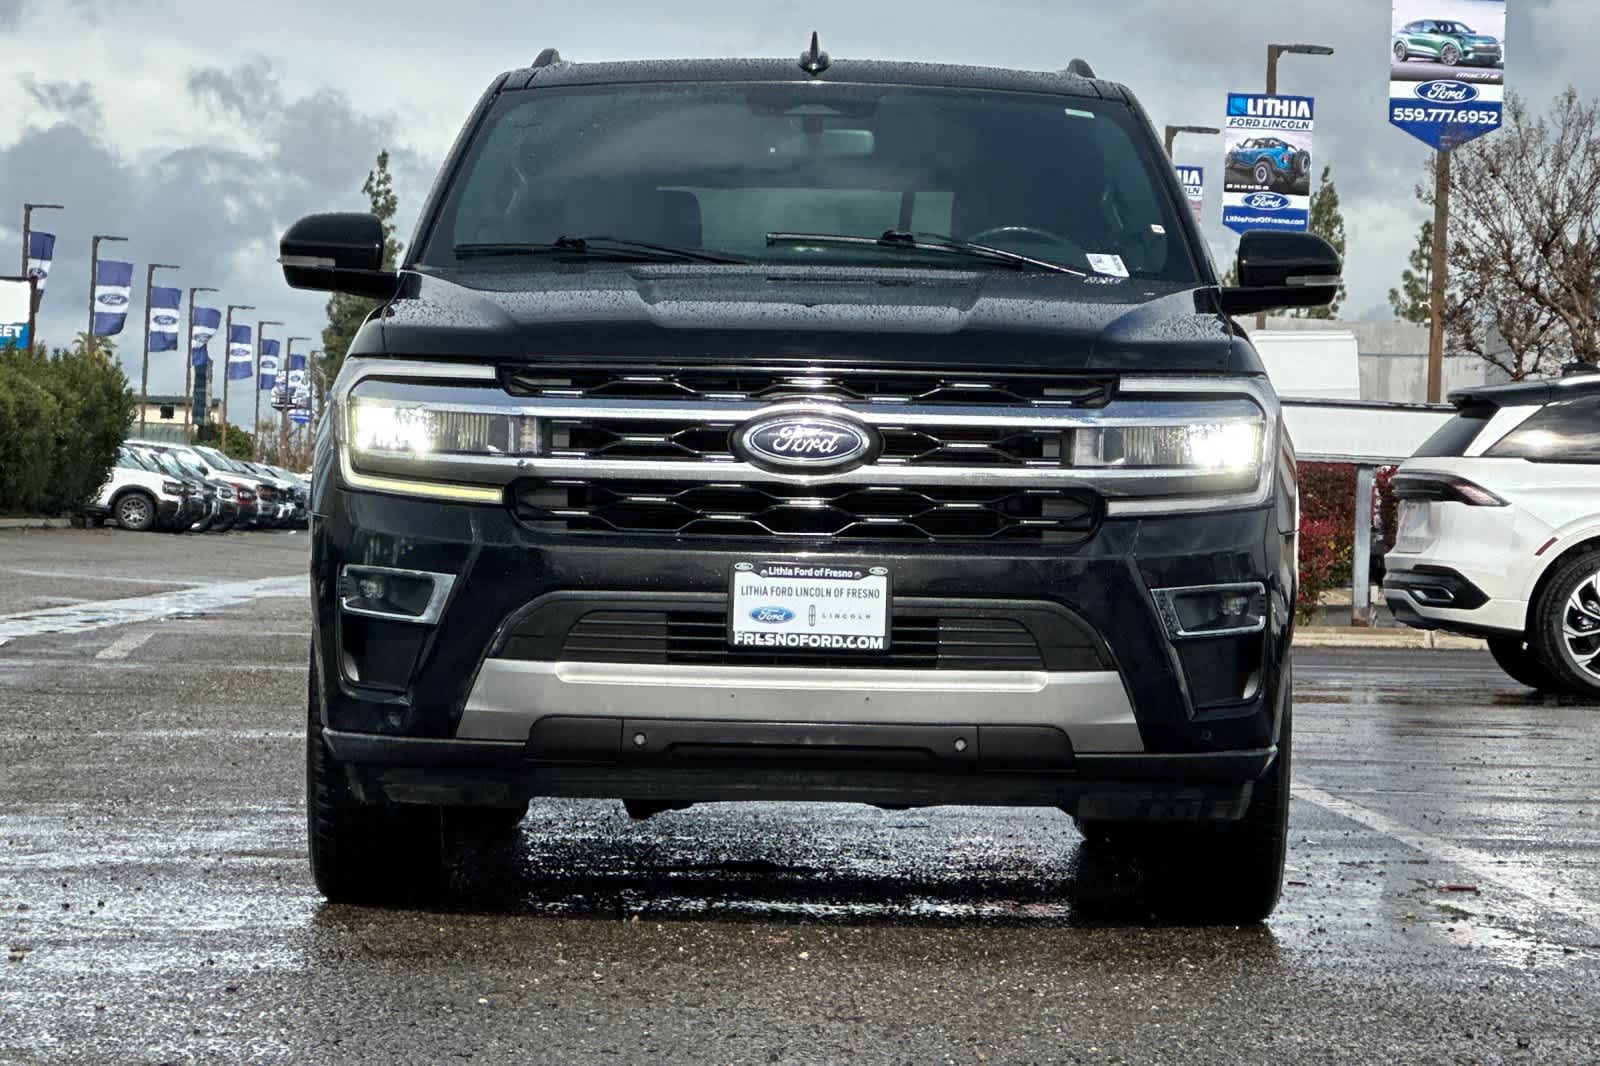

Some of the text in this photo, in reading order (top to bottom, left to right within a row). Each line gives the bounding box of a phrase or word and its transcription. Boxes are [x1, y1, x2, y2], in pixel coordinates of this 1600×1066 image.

[1427, 83, 1467, 100] Ford
[1247, 98, 1311, 118] LITHIA
[1230, 118, 1310, 129] FORD LINCOLN
[1393, 108, 1498, 124] 559.777.6952
[1251, 194, 1282, 207] Ford
[773, 426, 838, 454] Ford
[768, 566, 853, 578] Lithia Ford of Fresno
[741, 585, 880, 599] LITHIA FORD LINCOLN OF FRESNO
[758, 607, 785, 622] Ford
[734, 631, 884, 649] FRESNOFORD.COM
